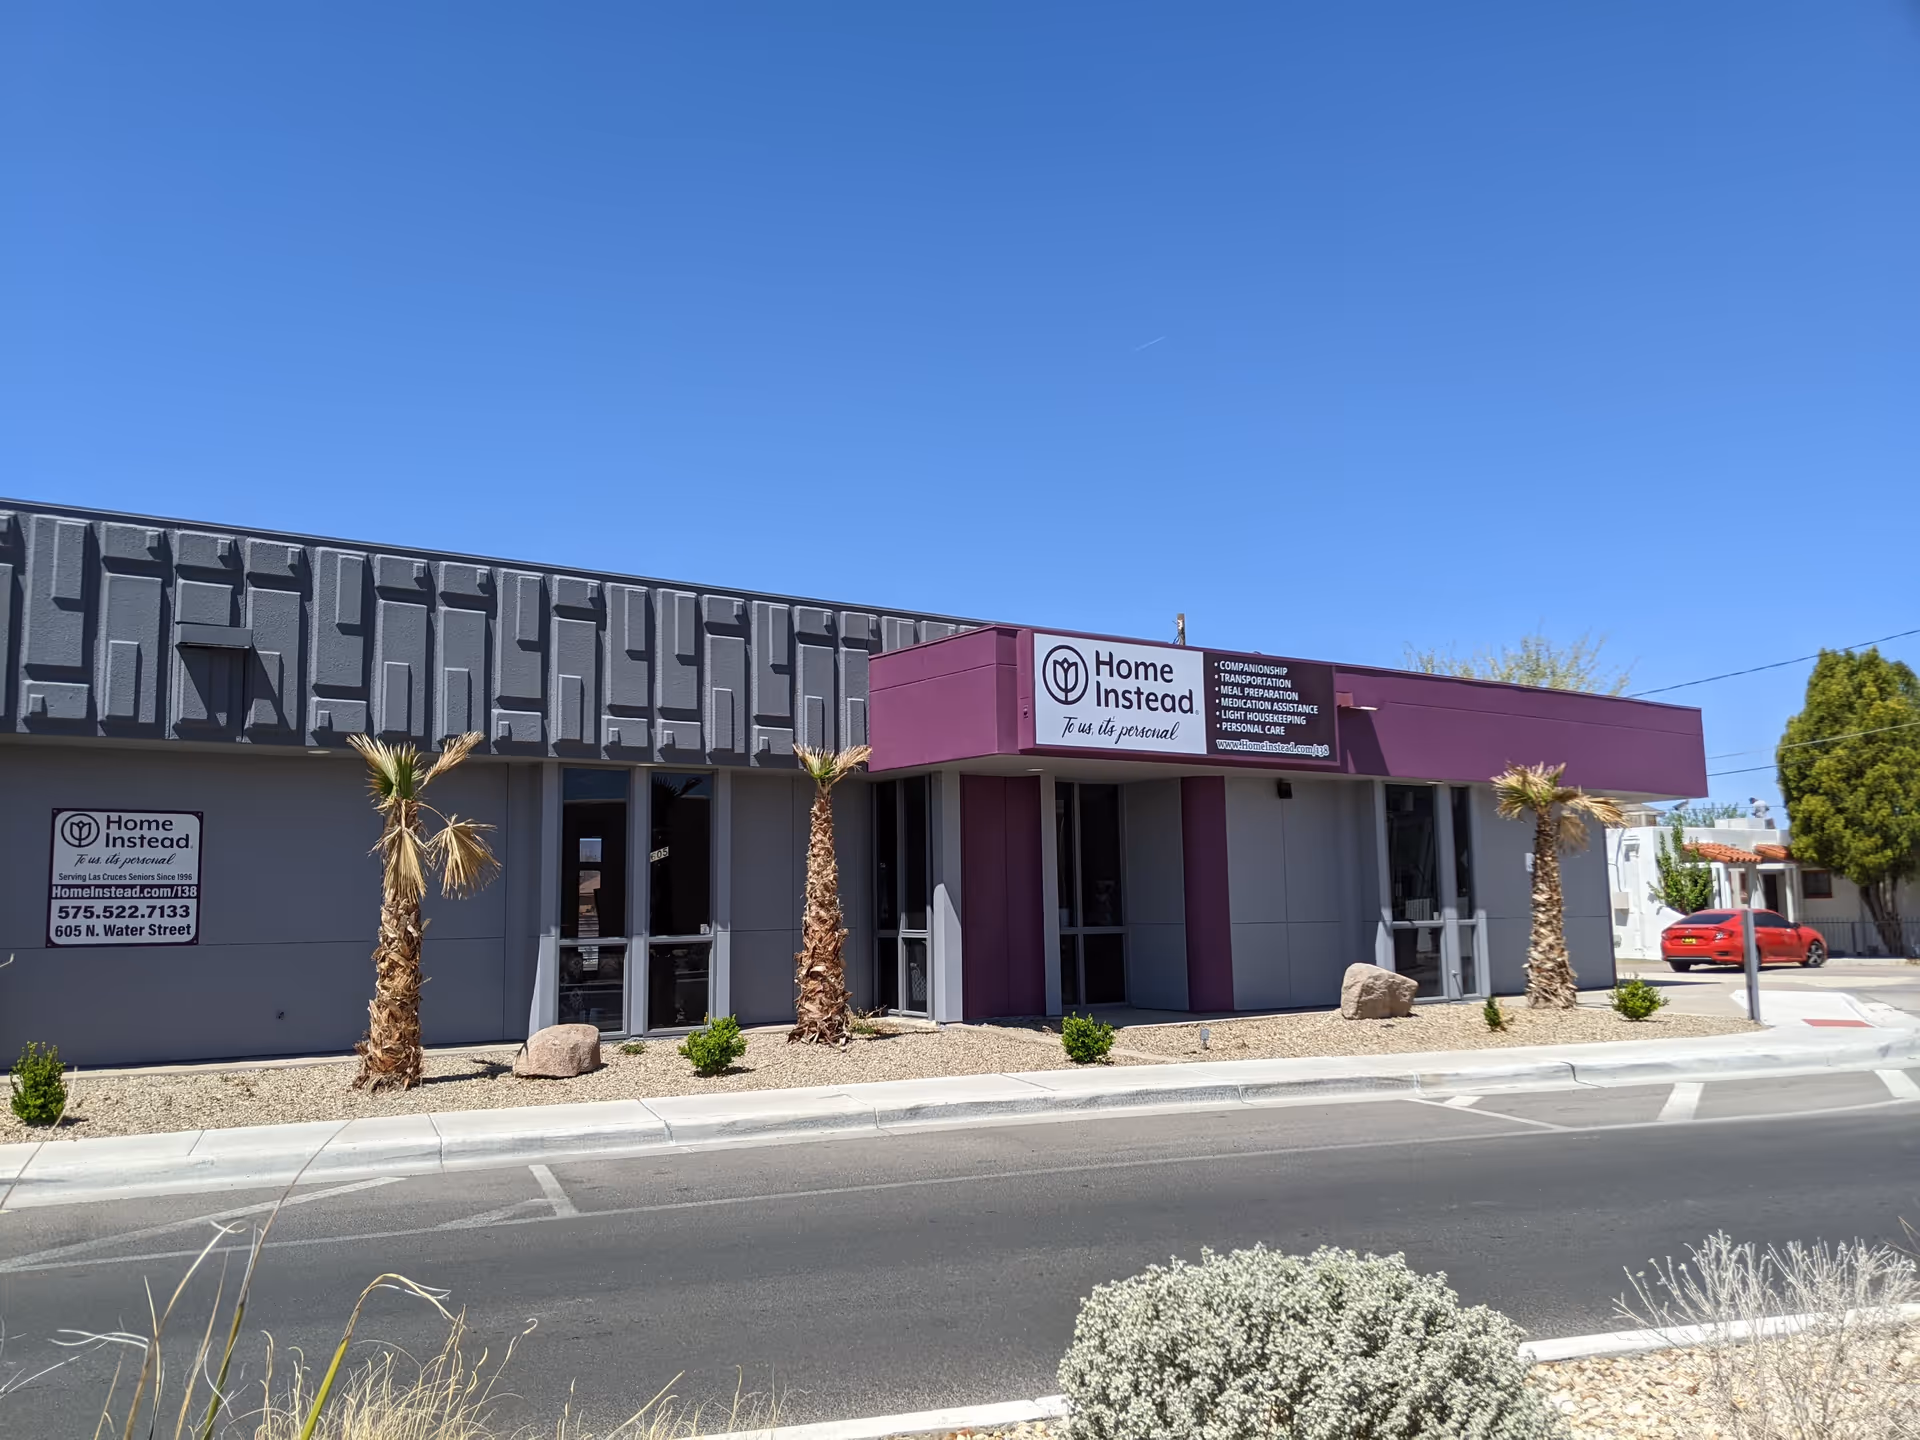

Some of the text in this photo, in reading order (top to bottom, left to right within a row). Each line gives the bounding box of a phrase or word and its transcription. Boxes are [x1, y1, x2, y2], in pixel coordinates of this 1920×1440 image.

[1096, 649, 1173, 683] Home
[1219, 660, 1288, 676] COMPANIONSHIP
[1220, 673, 1292, 688] TRANSPORTATION
[1096, 680, 1194, 714] Instead
[1220, 685, 1299, 701] MEAL PREPARATION
[1221, 697, 1319, 714] MEDICATION ASSISTANCE
[1221, 709, 1306, 725] LIGHT HOUSEKEEPING
[1062, 716, 1078, 738] To
[1115, 721, 1180, 745] personal
[1222, 721, 1286, 735] PERSONAL CARE
[1216, 739, 1330, 757] www.HomeInstead.com/138
[106, 814, 174, 831] Home
[105, 832, 190, 849] Instead
[74, 853, 88, 867] To
[118, 853, 177, 869] personal
[650, 847, 669, 861] 605
[58, 872, 87, 882] Serving
[88, 873, 101, 881] Las
[102, 873, 127, 881] Cruces
[128, 873, 155, 881] Seniors
[156, 873, 176, 881] Since
[52, 885, 197, 898] HomeInstead.com/138
[57, 905, 190, 919] 575.522.7133
[55, 923, 192, 937] 605 N. Water Street
